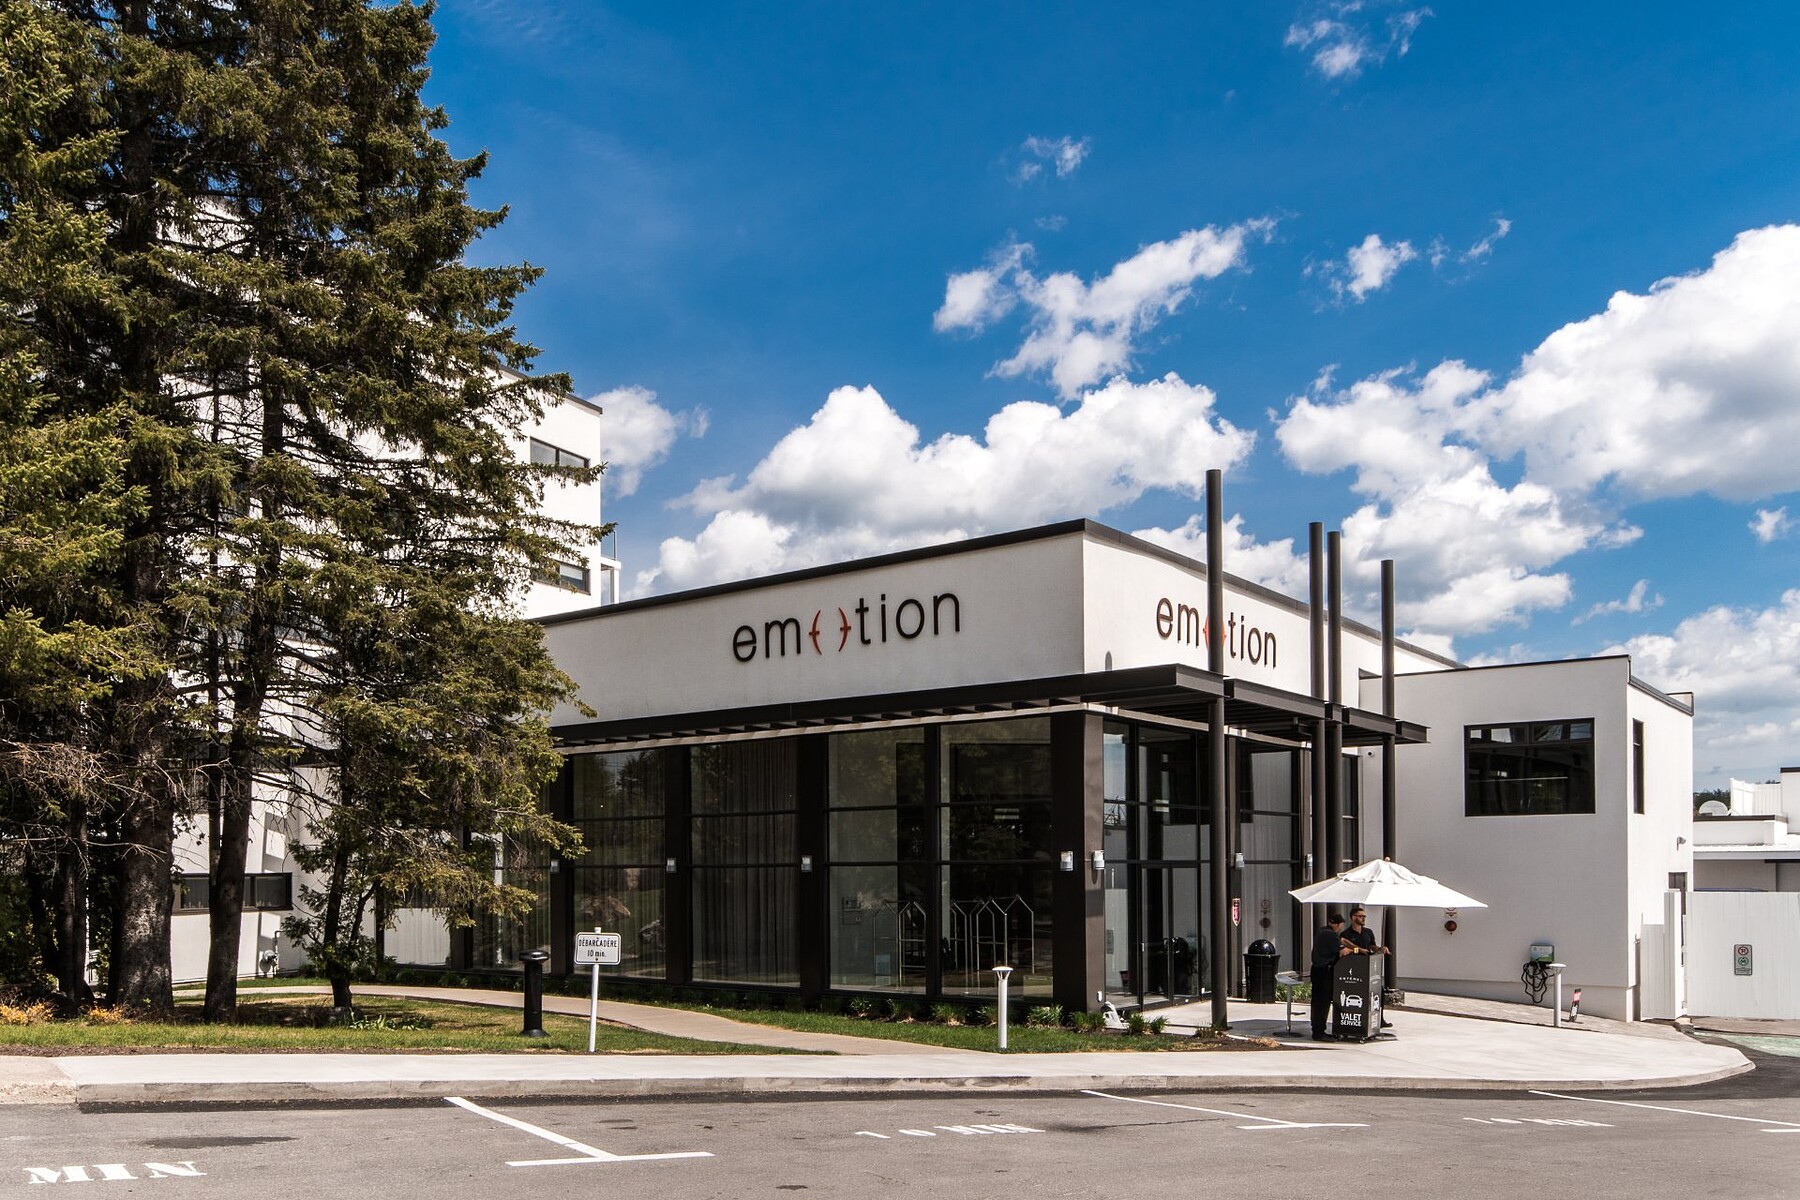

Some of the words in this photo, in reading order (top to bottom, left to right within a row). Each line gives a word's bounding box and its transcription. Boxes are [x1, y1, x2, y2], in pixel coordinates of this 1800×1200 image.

[587, 949, 595, 957] 10
[1340, 1012, 1362, 1021] VALET
[22, 1161, 207, 1184] MIN
